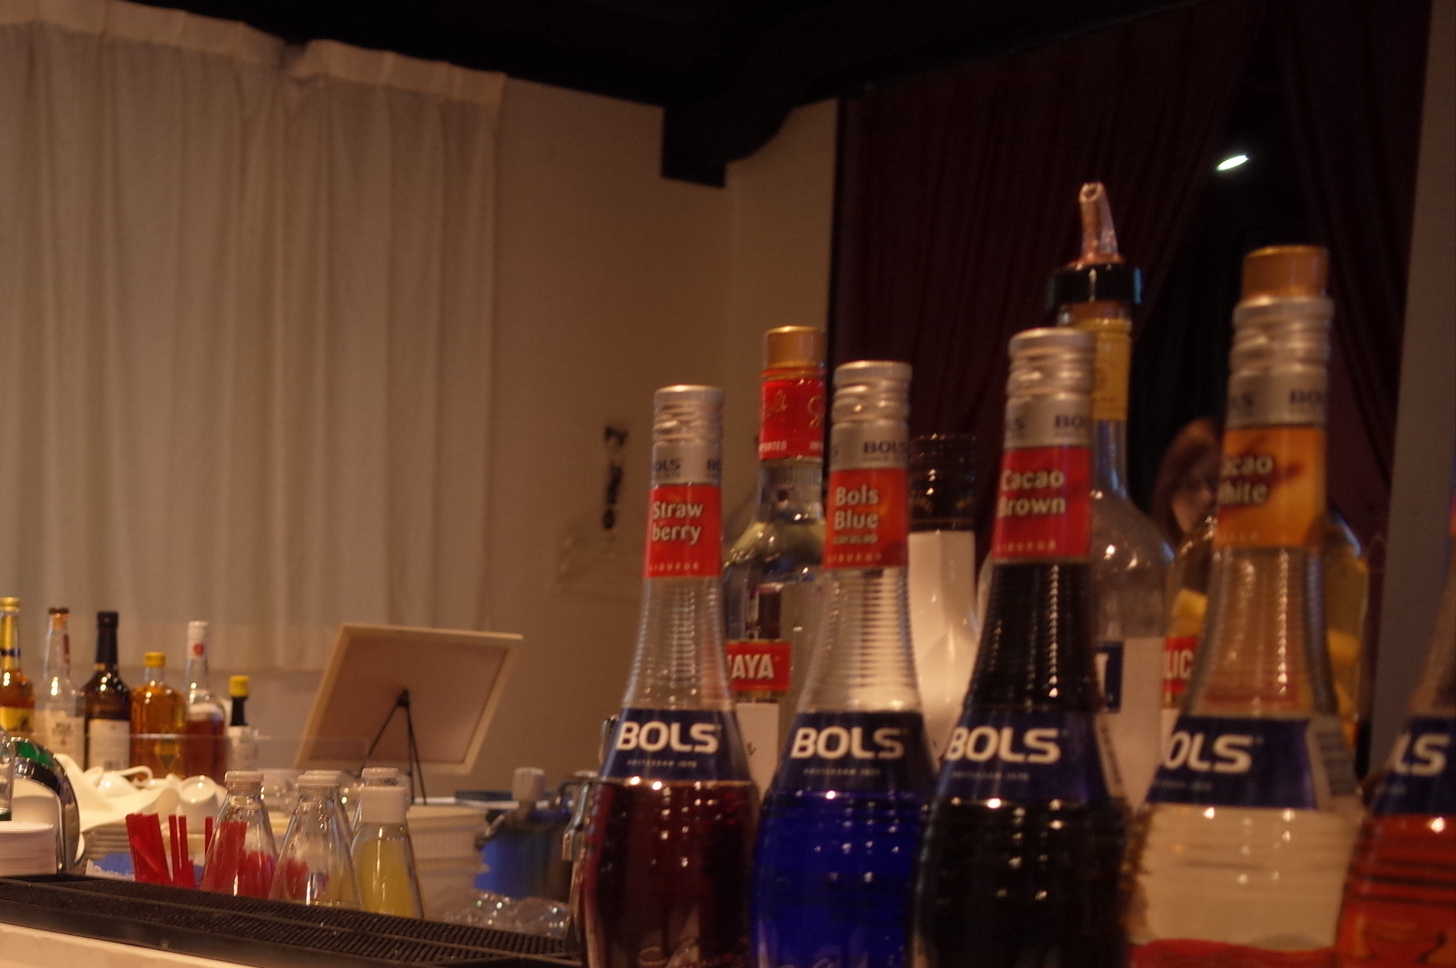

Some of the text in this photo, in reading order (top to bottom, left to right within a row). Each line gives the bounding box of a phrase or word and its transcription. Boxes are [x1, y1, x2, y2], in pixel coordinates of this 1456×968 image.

[654, 459, 681, 471] OLS
[835, 484, 880, 506] Bols
[652, 501, 704, 520] Straw
[834, 511, 879, 530] Blue
[652, 523, 702, 546] berry
[728, 653, 775, 680] AYA
[616, 721, 720, 754] BOLS
[790, 726, 905, 761] BOLS
[947, 726, 1062, 764] BOLS
[1163, 731, 1254, 774] OLS
[1394, 733, 1449, 776] LS
